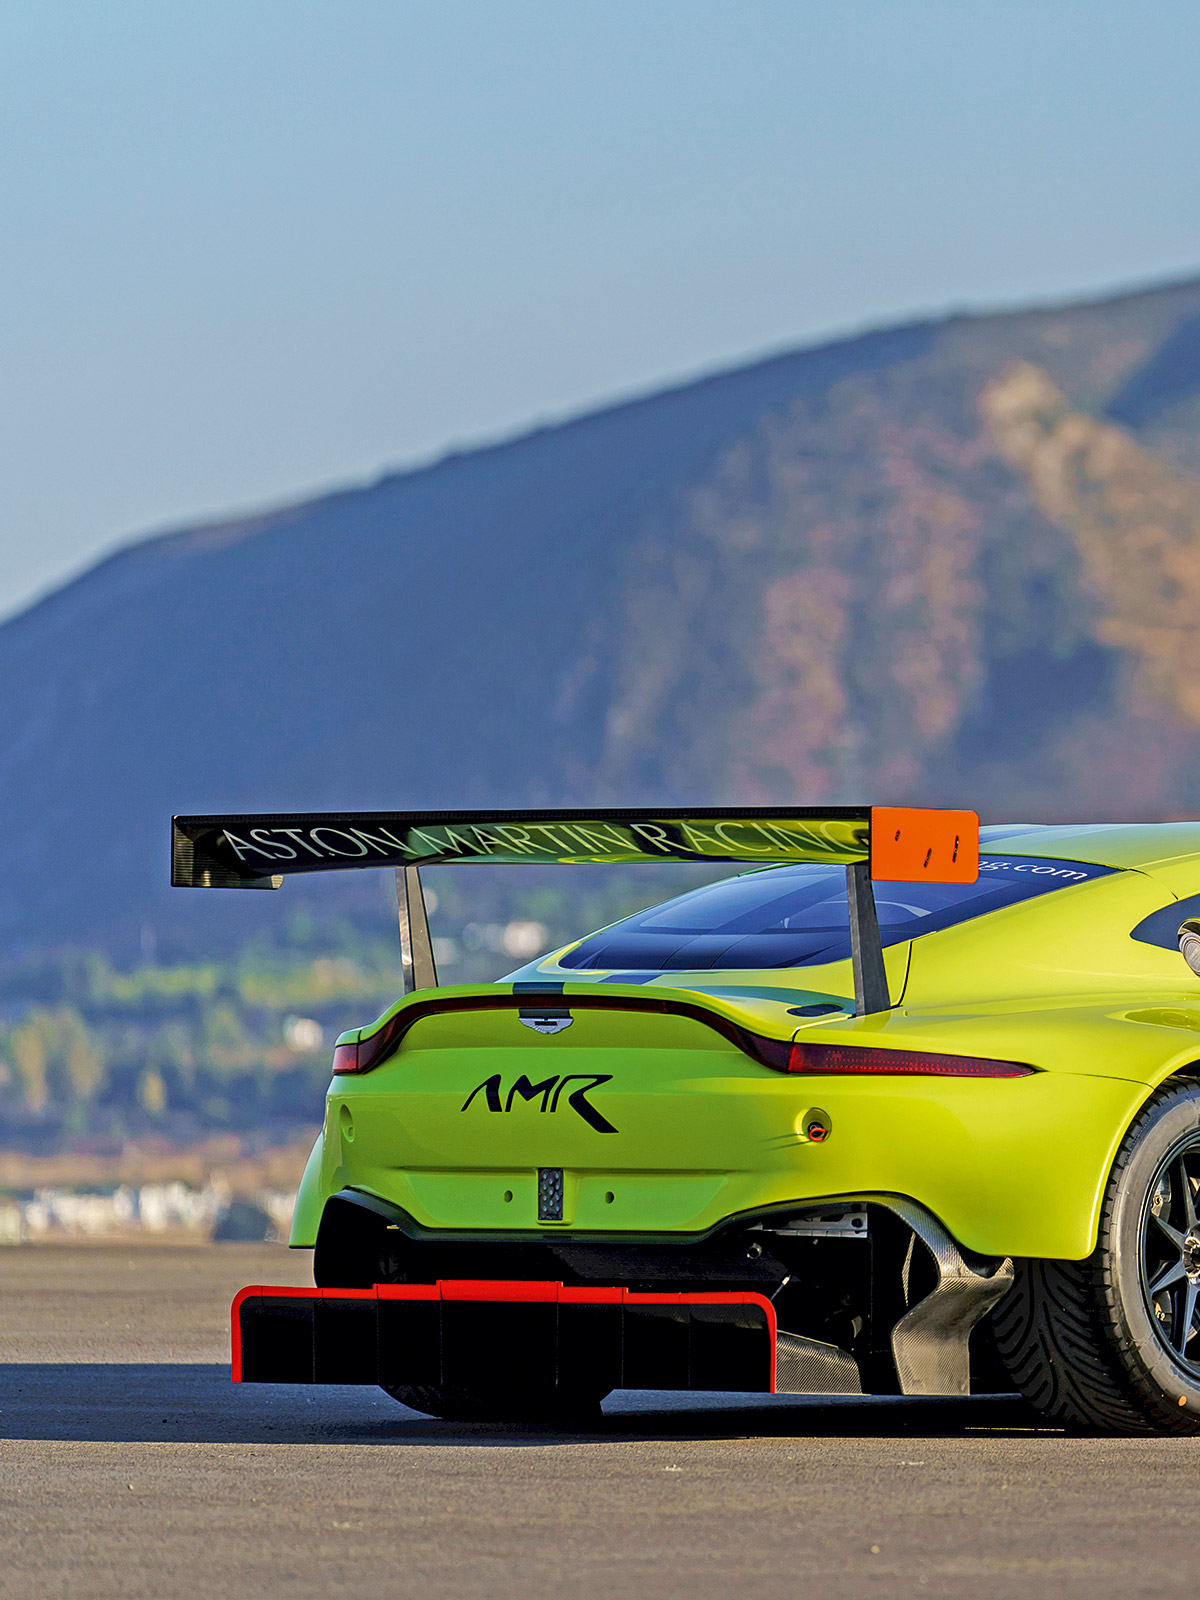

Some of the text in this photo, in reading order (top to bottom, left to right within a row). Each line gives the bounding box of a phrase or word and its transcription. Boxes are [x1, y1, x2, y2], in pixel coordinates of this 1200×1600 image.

[222, 821, 869, 861] ASTON MARTIN RACING
[460, 1073, 620, 1134] AMR
